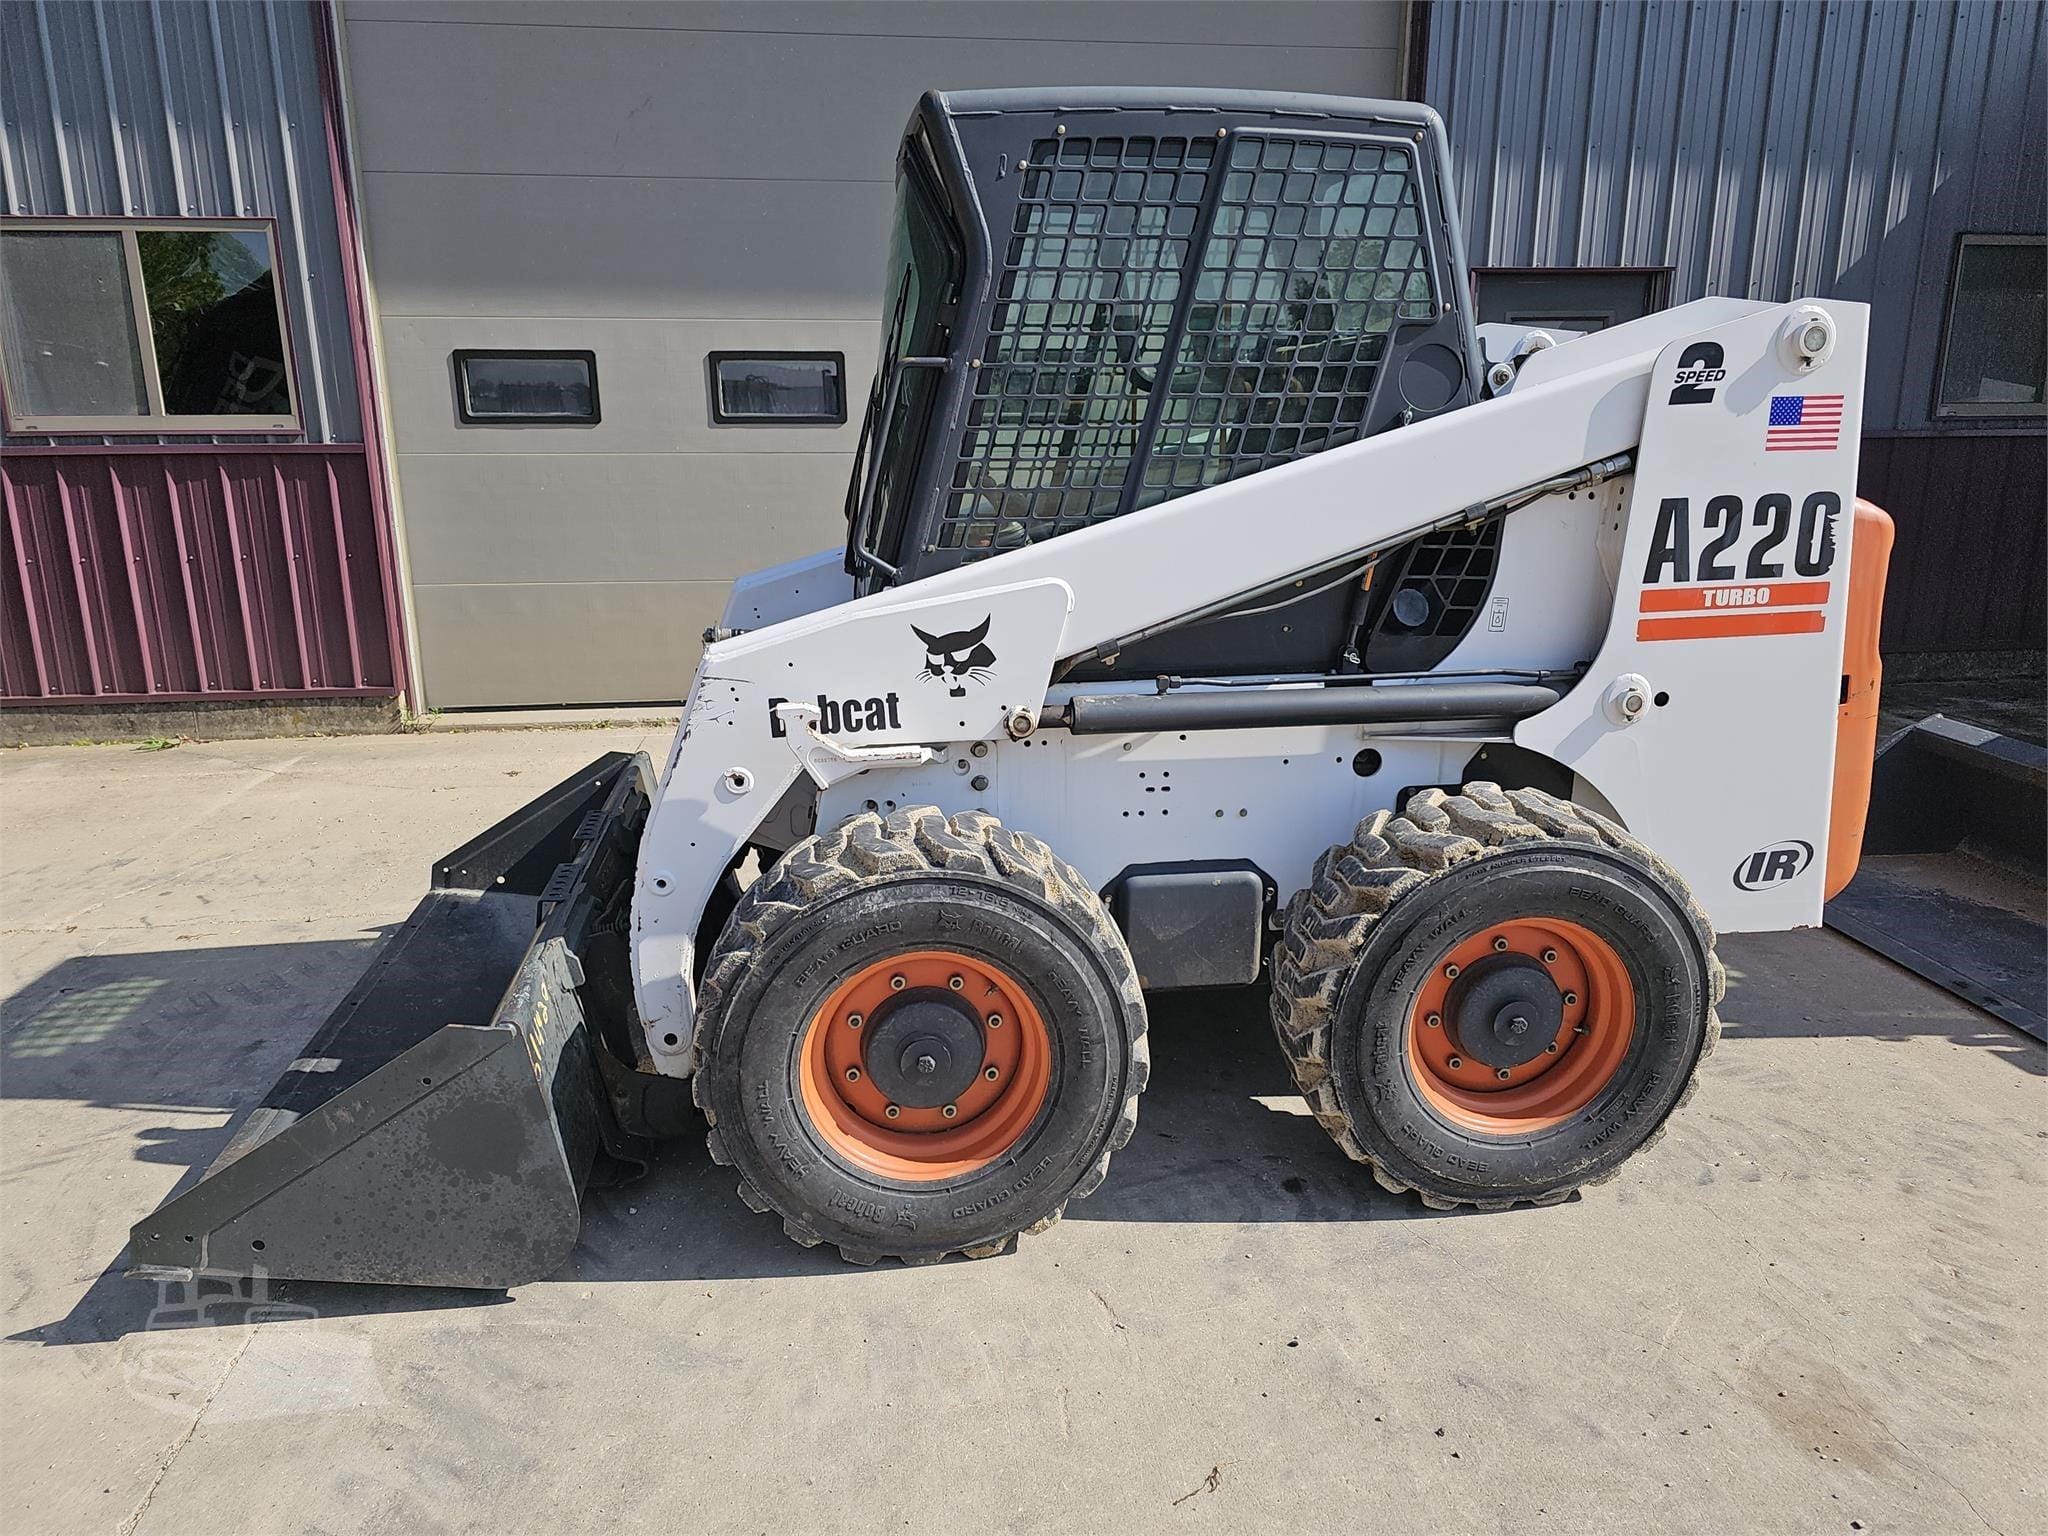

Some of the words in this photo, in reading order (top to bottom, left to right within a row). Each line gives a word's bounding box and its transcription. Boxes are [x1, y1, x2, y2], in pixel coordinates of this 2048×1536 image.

[1668, 341, 1725, 405] 2
[1673, 369, 1727, 384] SPEED
[1642, 491, 1842, 584] A220
[1702, 587, 1771, 607] TURBO
[1745, 849, 1800, 883] IR
[1569, 886, 1611, 907] BEAD
[1613, 904, 1663, 943] GUARD
[795, 948, 838, 988] BEAD
[840, 920, 903, 951] GUARD
[969, 918, 1025, 954] Bobcat
[1388, 942, 1428, 993] HEAVY
[756, 1079, 775, 1126] WALL
[1625, 1070, 1661, 1121] HEAVY
[768, 1132, 810, 1182] HEAVY
[1402, 1120, 1445, 1161] GUARD
[1013, 1156, 1053, 1191] BEAD
[1446, 1152, 1490, 1174] BEAD
[827, 1188, 888, 1223] Bobcat
[952, 1188, 1012, 1219] GUARD
